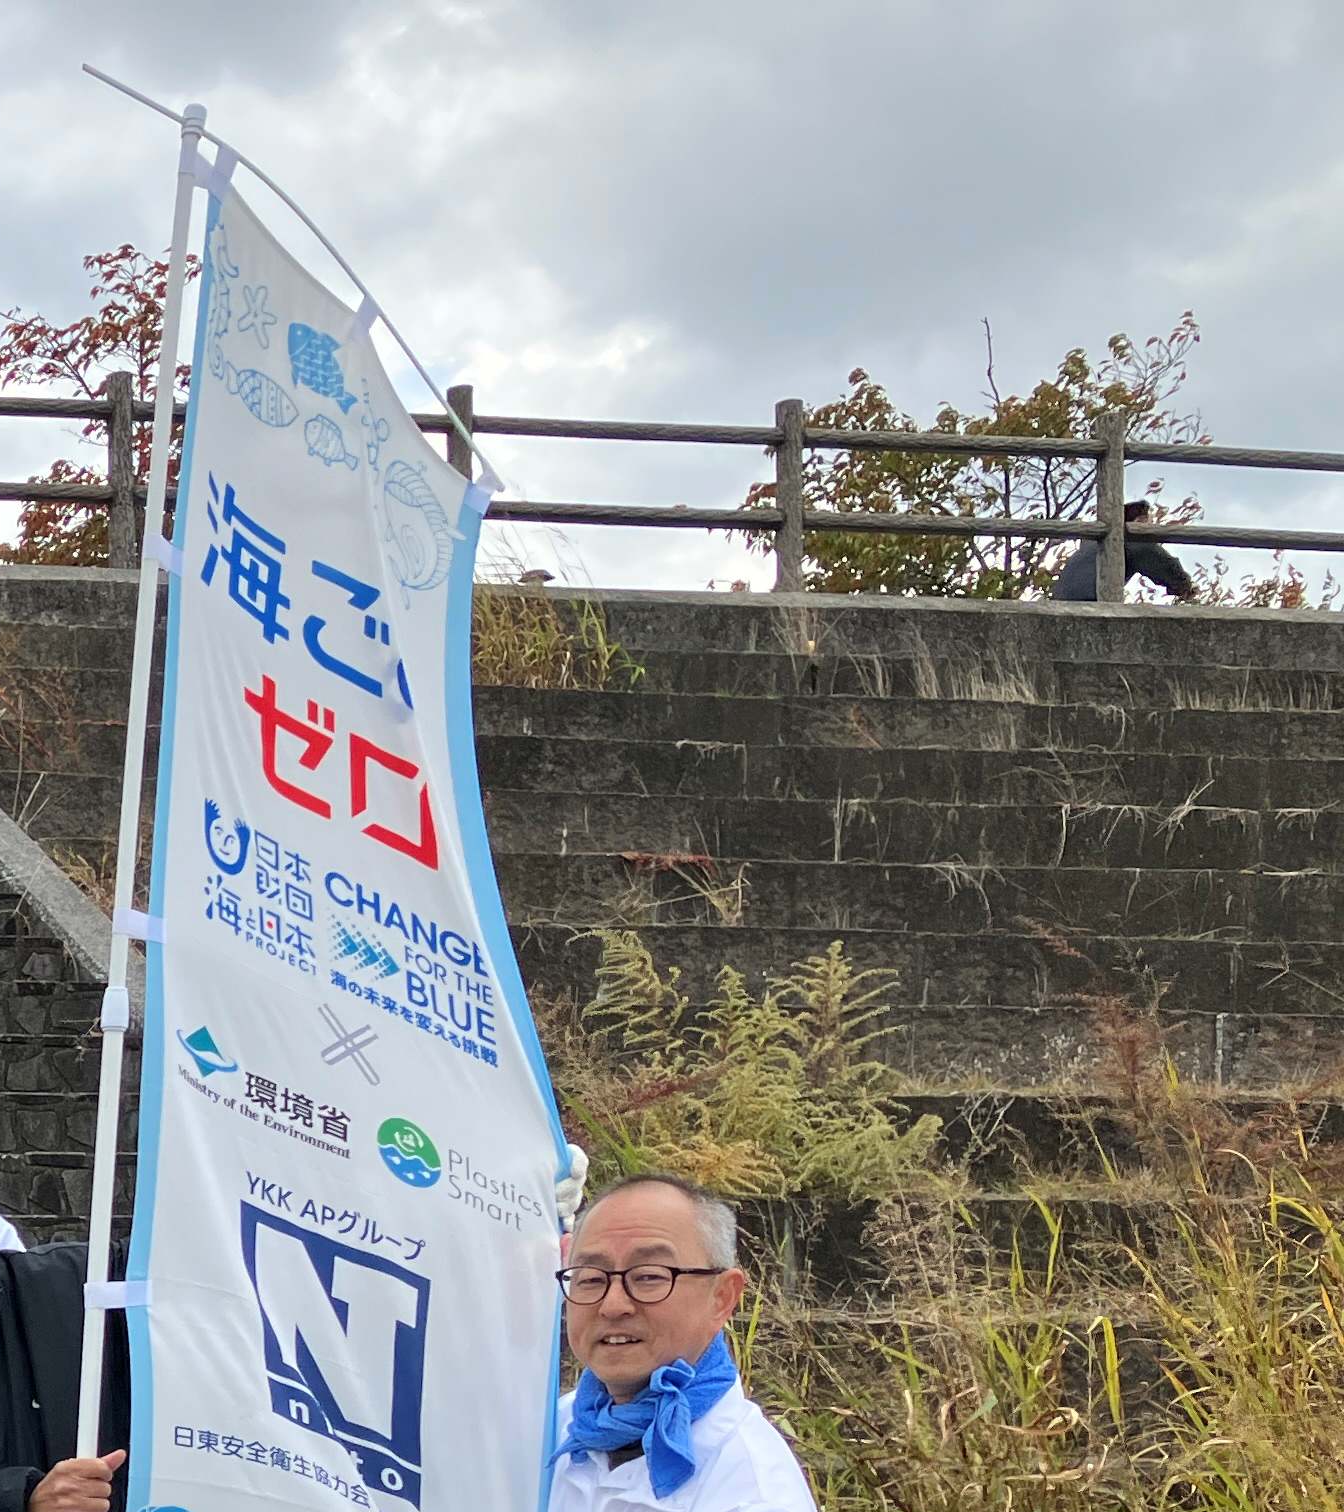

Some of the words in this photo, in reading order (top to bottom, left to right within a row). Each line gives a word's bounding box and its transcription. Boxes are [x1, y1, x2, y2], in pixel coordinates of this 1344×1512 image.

[201, 470, 414, 710] 海ご
[244, 673, 439, 871] ゼロ
[255, 829, 311, 882] 日本
[256, 864, 313, 922] 財団
[244, 931, 318, 976] PROJECT
[323, 871, 489, 978] CHANGE
[404, 945, 447, 985] FOR
[454, 971, 494, 1007] THE
[406, 970, 496, 1046] BLUE
[329, 968, 499, 1069] 海の未来を変える挑戦
[178, 1063, 221, 1104] Ministry
[223, 1096, 237, 1110] of
[239, 1103, 261, 1122] the
[263, 1113, 351, 1160] Environment
[244, 1070, 352, 1143] 環境省
[245, 1170, 292, 1212] YKK
[299, 1198, 427, 1261] APグループ
[448, 1149, 543, 1218] Plastics
[448, 1175, 523, 1232] Smart
[174, 1425, 371, 1509] 日東安全衛生協力会
